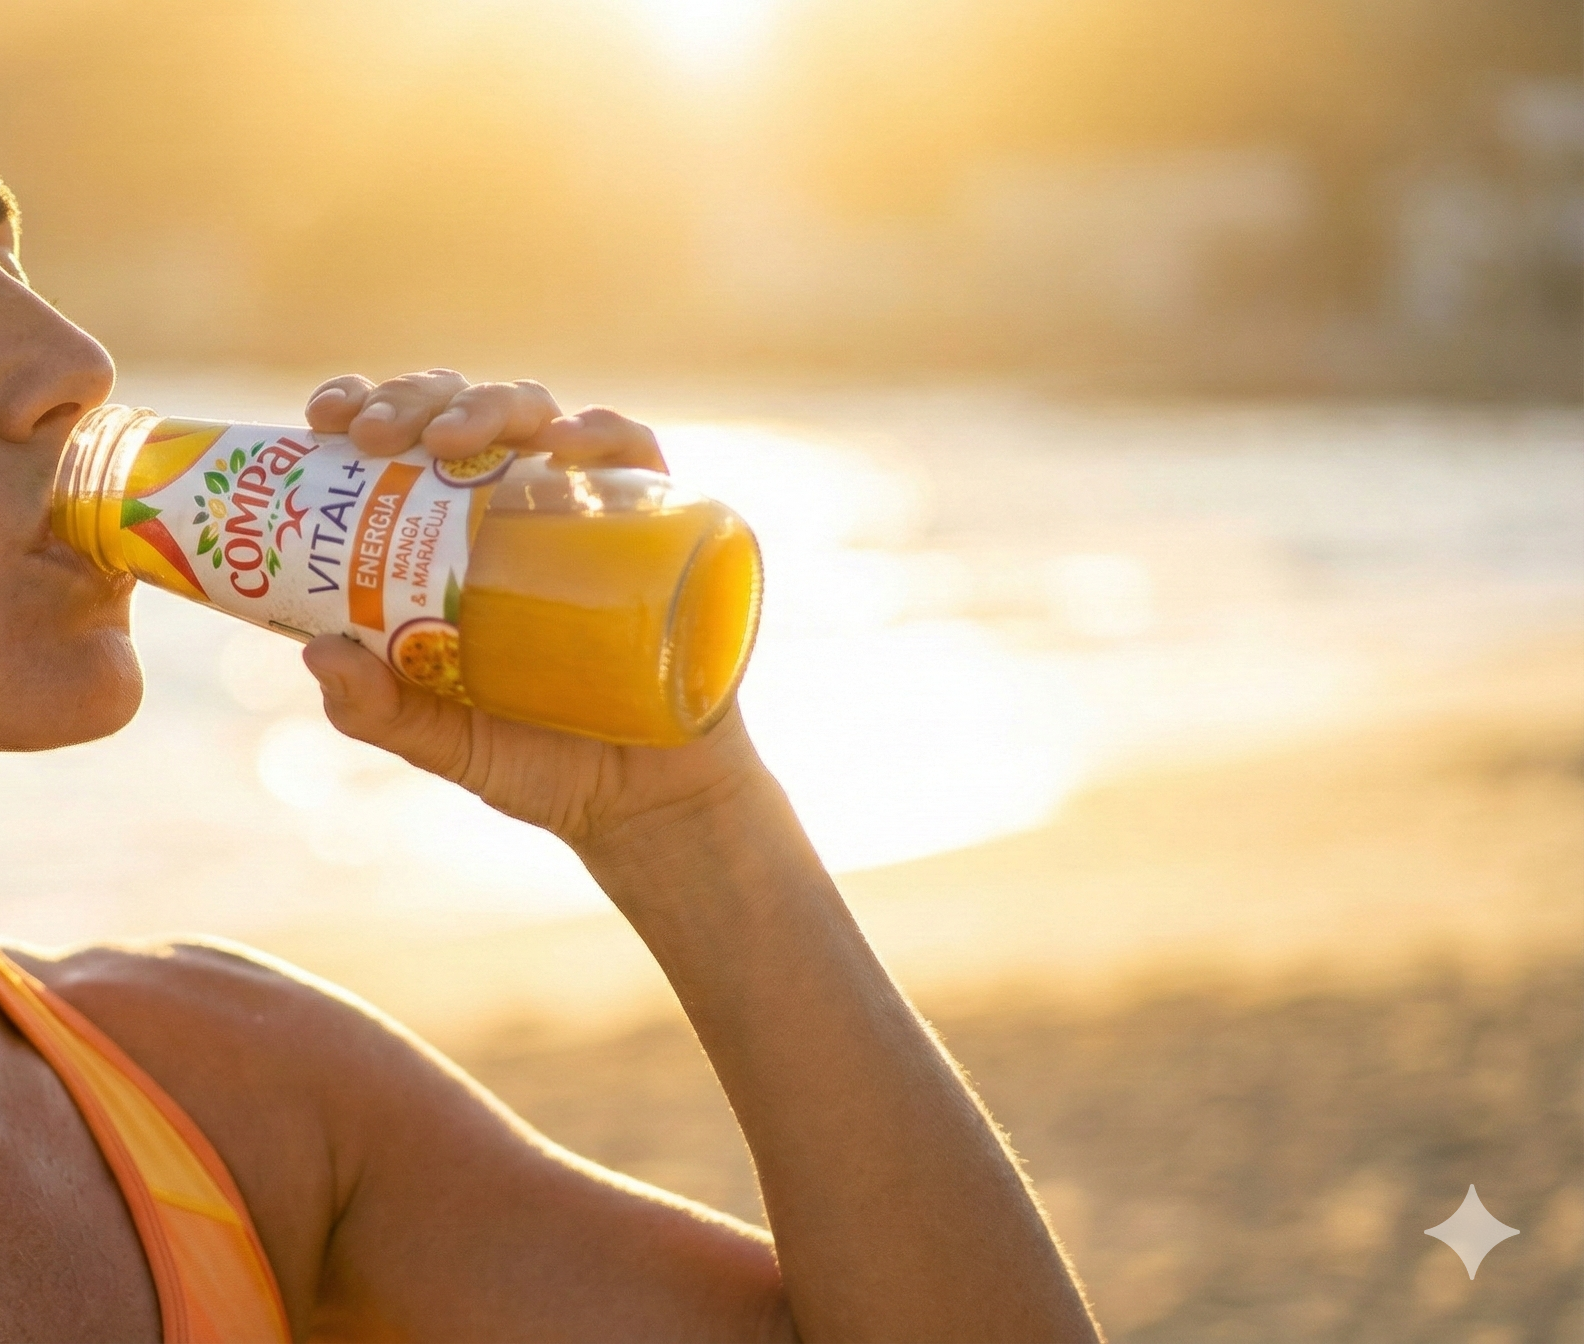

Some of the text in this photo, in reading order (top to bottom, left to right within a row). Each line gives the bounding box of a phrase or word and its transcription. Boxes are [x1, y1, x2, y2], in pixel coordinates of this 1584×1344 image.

[308, 460, 366, 594] VITAL+
[356, 493, 402, 589] ENERGIA
[391, 516, 422, 580] MANGA
[410, 594, 426, 607] &
